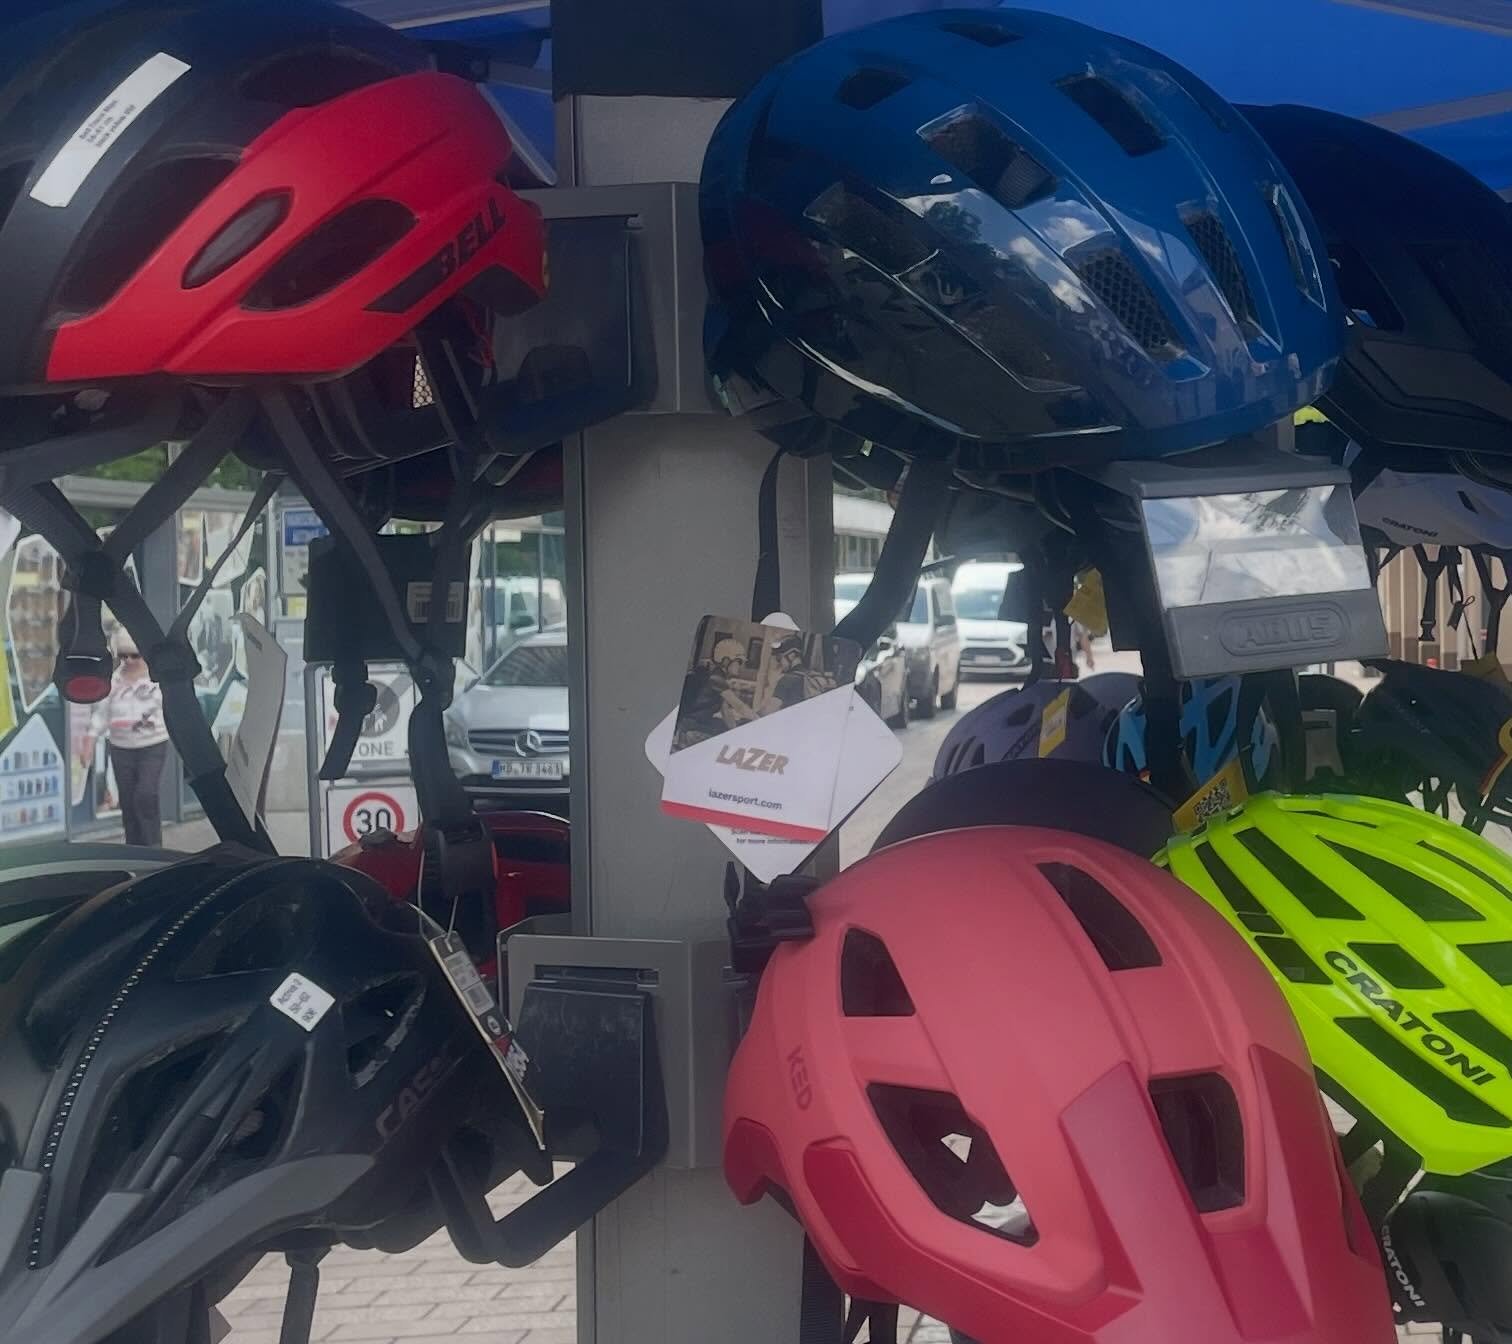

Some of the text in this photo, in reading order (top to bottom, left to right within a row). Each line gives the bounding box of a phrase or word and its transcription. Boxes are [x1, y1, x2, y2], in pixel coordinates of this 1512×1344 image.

[440, 197, 506, 278] BELL
[1382, 516, 1439, 537] CRATONI
[1231, 613, 1333, 652] ABUS
[357, 740, 395, 757] ONE
[715, 744, 790, 775] LAZER
[708, 788, 783, 810] lazersport.com
[356, 808, 391, 834] 30
[1325, 951, 1496, 1086] CRATONI
[786, 1044, 812, 1111] KED
[1381, 1225, 1425, 1307] CRATONI
